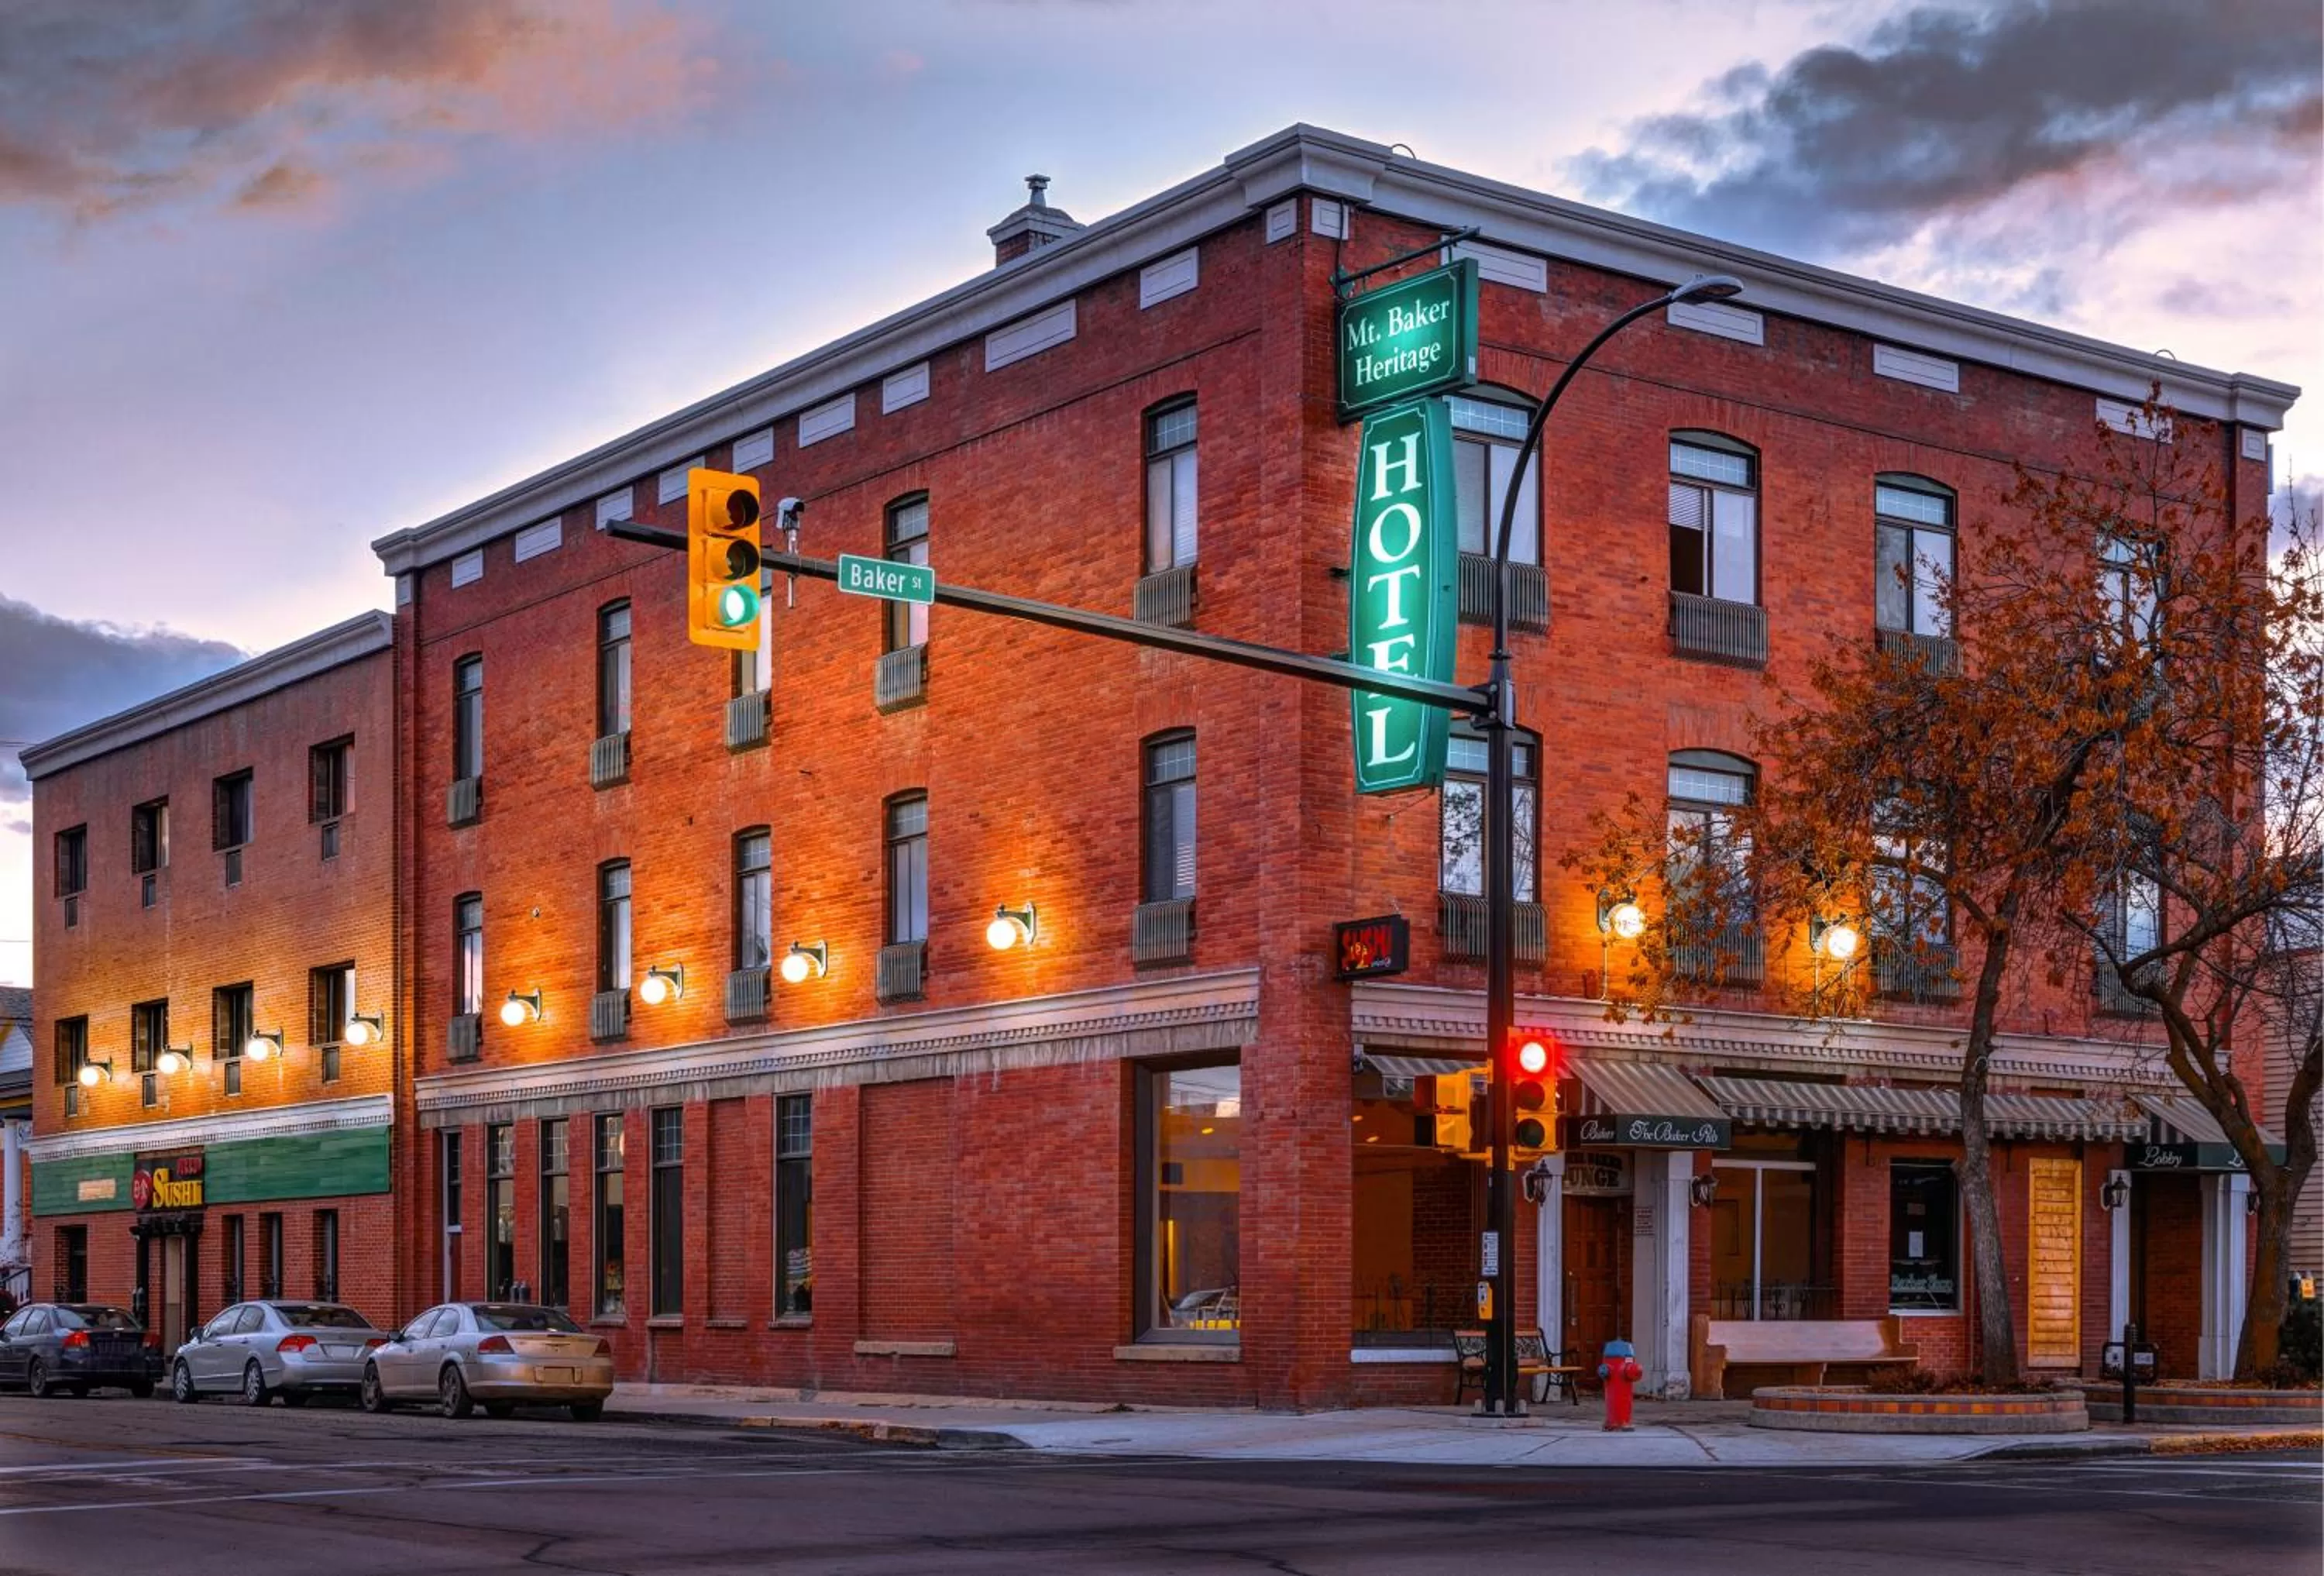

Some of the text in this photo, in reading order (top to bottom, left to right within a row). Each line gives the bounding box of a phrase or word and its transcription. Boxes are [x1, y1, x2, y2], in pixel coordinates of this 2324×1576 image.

[1347, 298, 1449, 351] Mt. Baker
[1355, 342, 1441, 387] Heritage
[851, 563, 906, 593] Baker
[1580, 1120, 1615, 1141] Baker
[1629, 1120, 1718, 1144] The Baker Pub
[2138, 1145, 2182, 1168] Lobby
